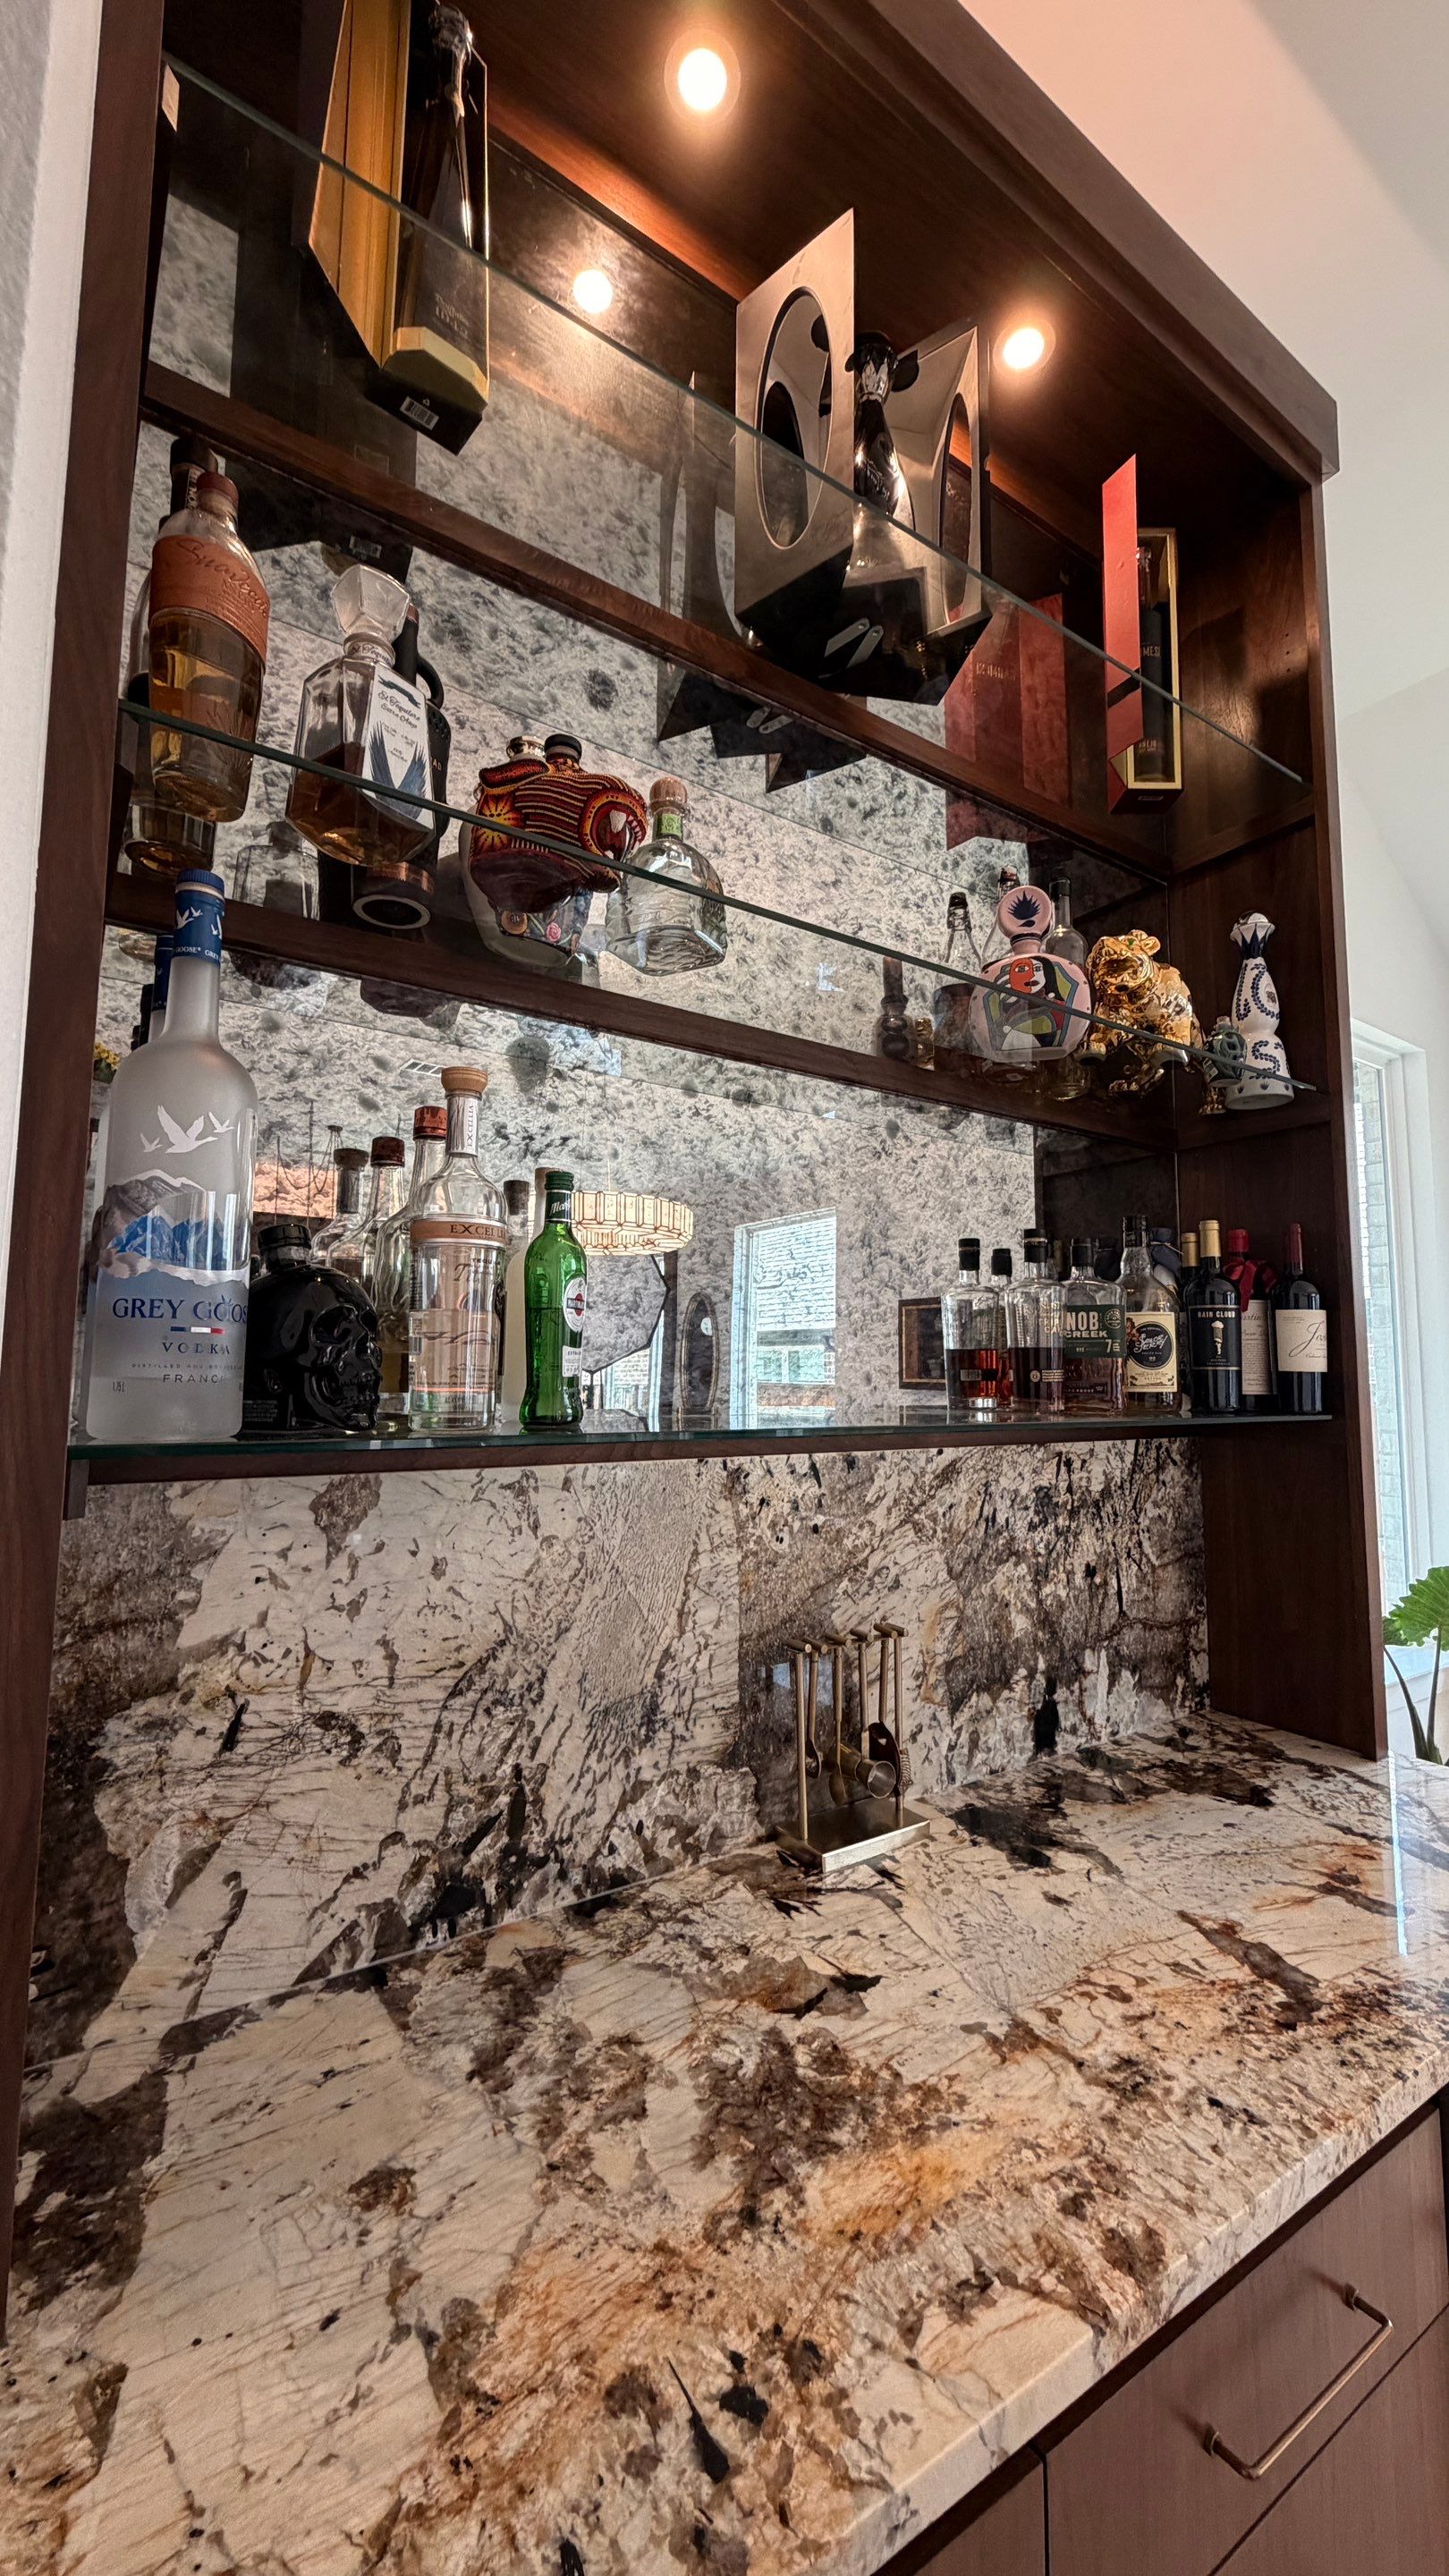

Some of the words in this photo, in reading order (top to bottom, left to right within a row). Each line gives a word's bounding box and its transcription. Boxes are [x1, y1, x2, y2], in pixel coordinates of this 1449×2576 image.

[112, 1298, 186, 1318] GREY
[192, 1300, 247, 1325] GOOS
[1216, 1310, 1235, 1318] CLOUD
